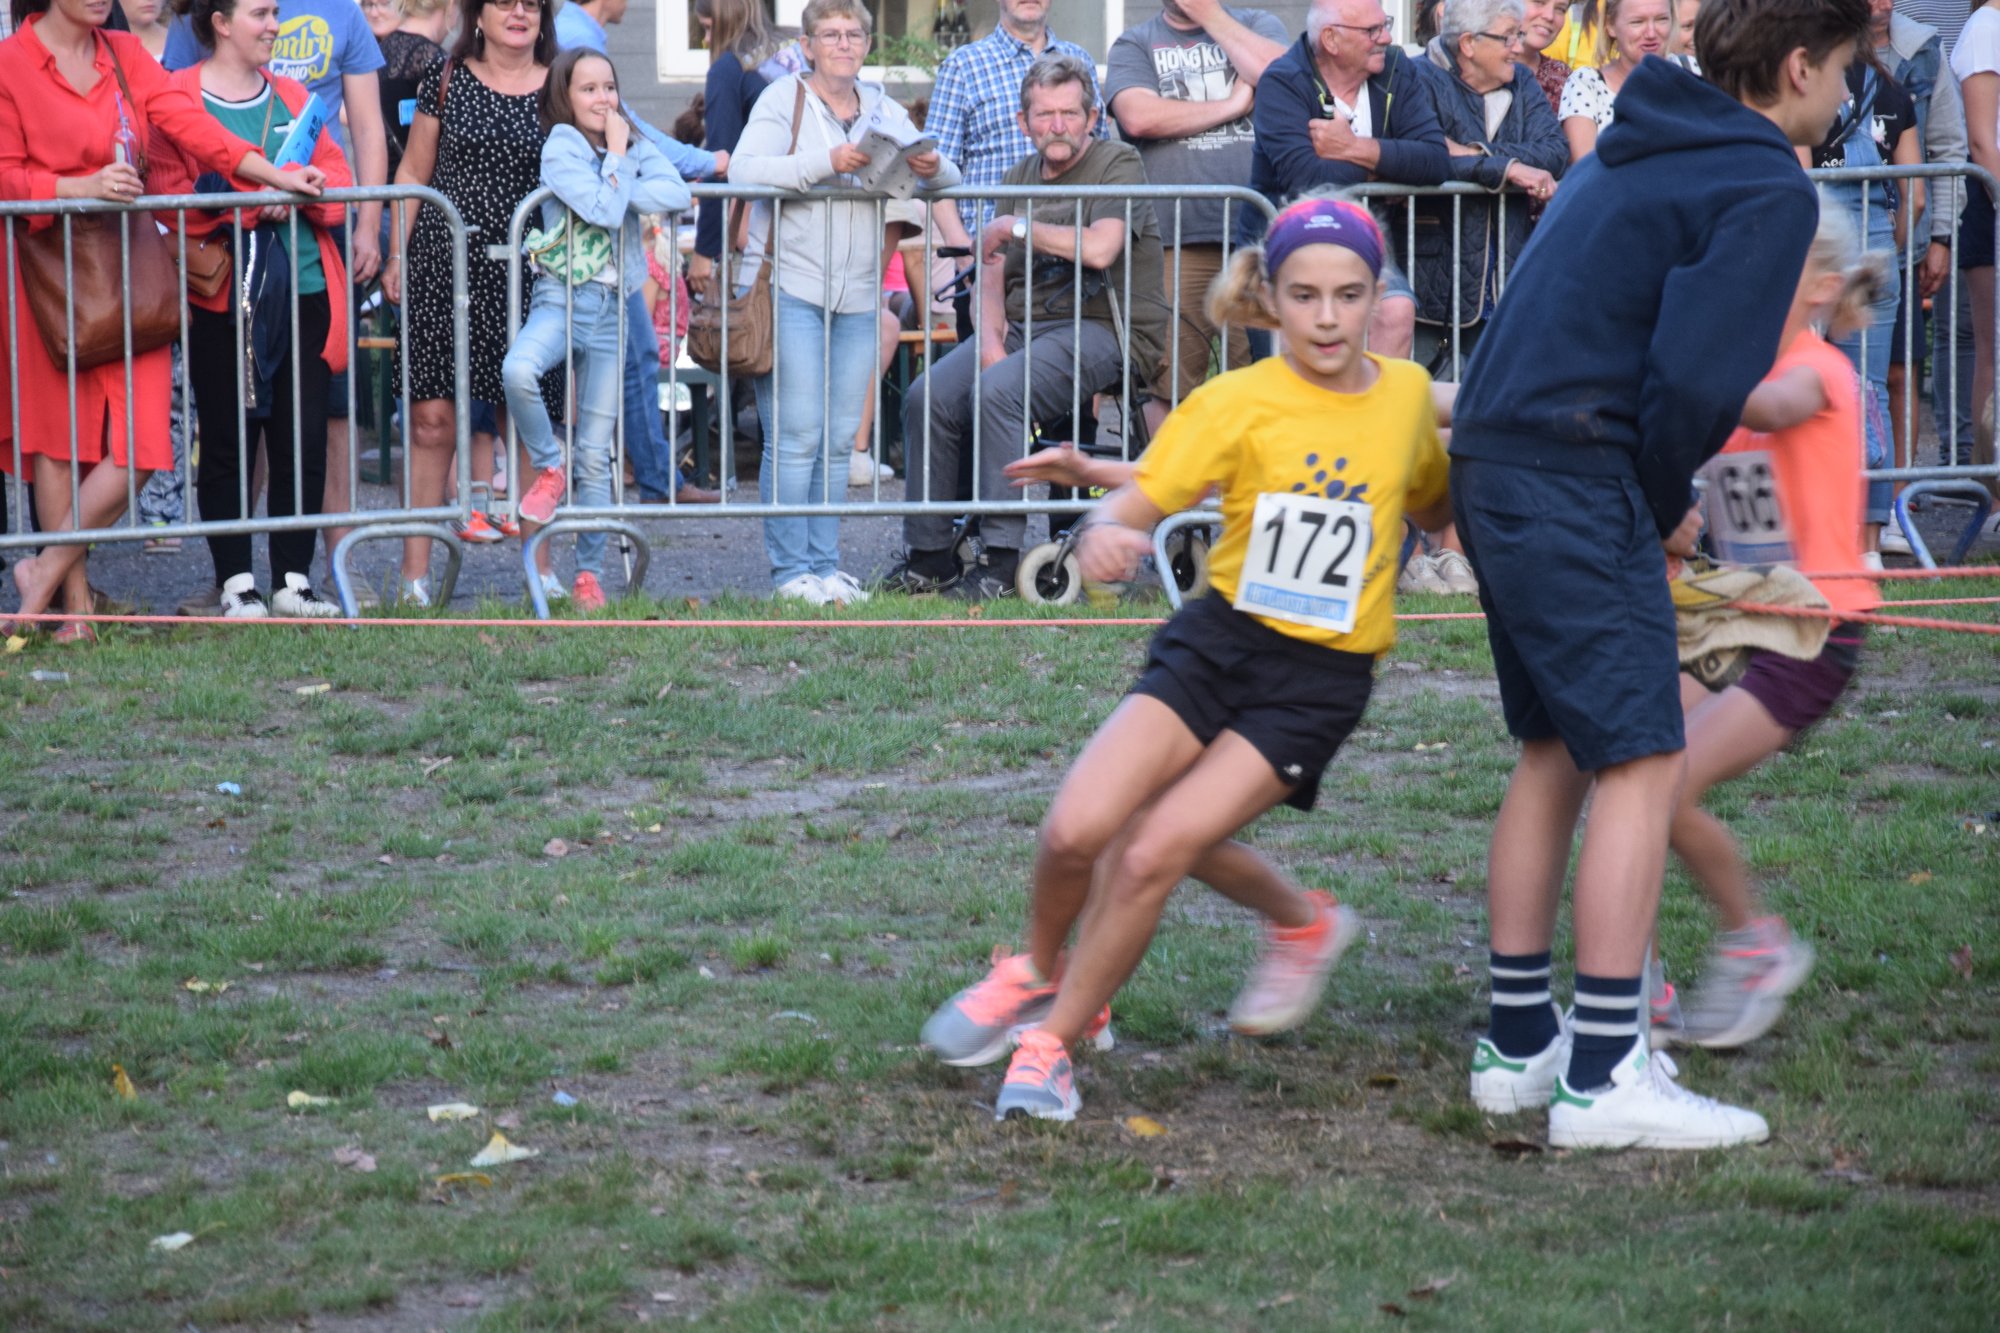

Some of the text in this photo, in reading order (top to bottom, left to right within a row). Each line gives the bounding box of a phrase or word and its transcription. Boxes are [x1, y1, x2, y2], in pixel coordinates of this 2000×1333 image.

[1153, 43, 1228, 75] HONG KO
[1264, 506, 1356, 587] 172
